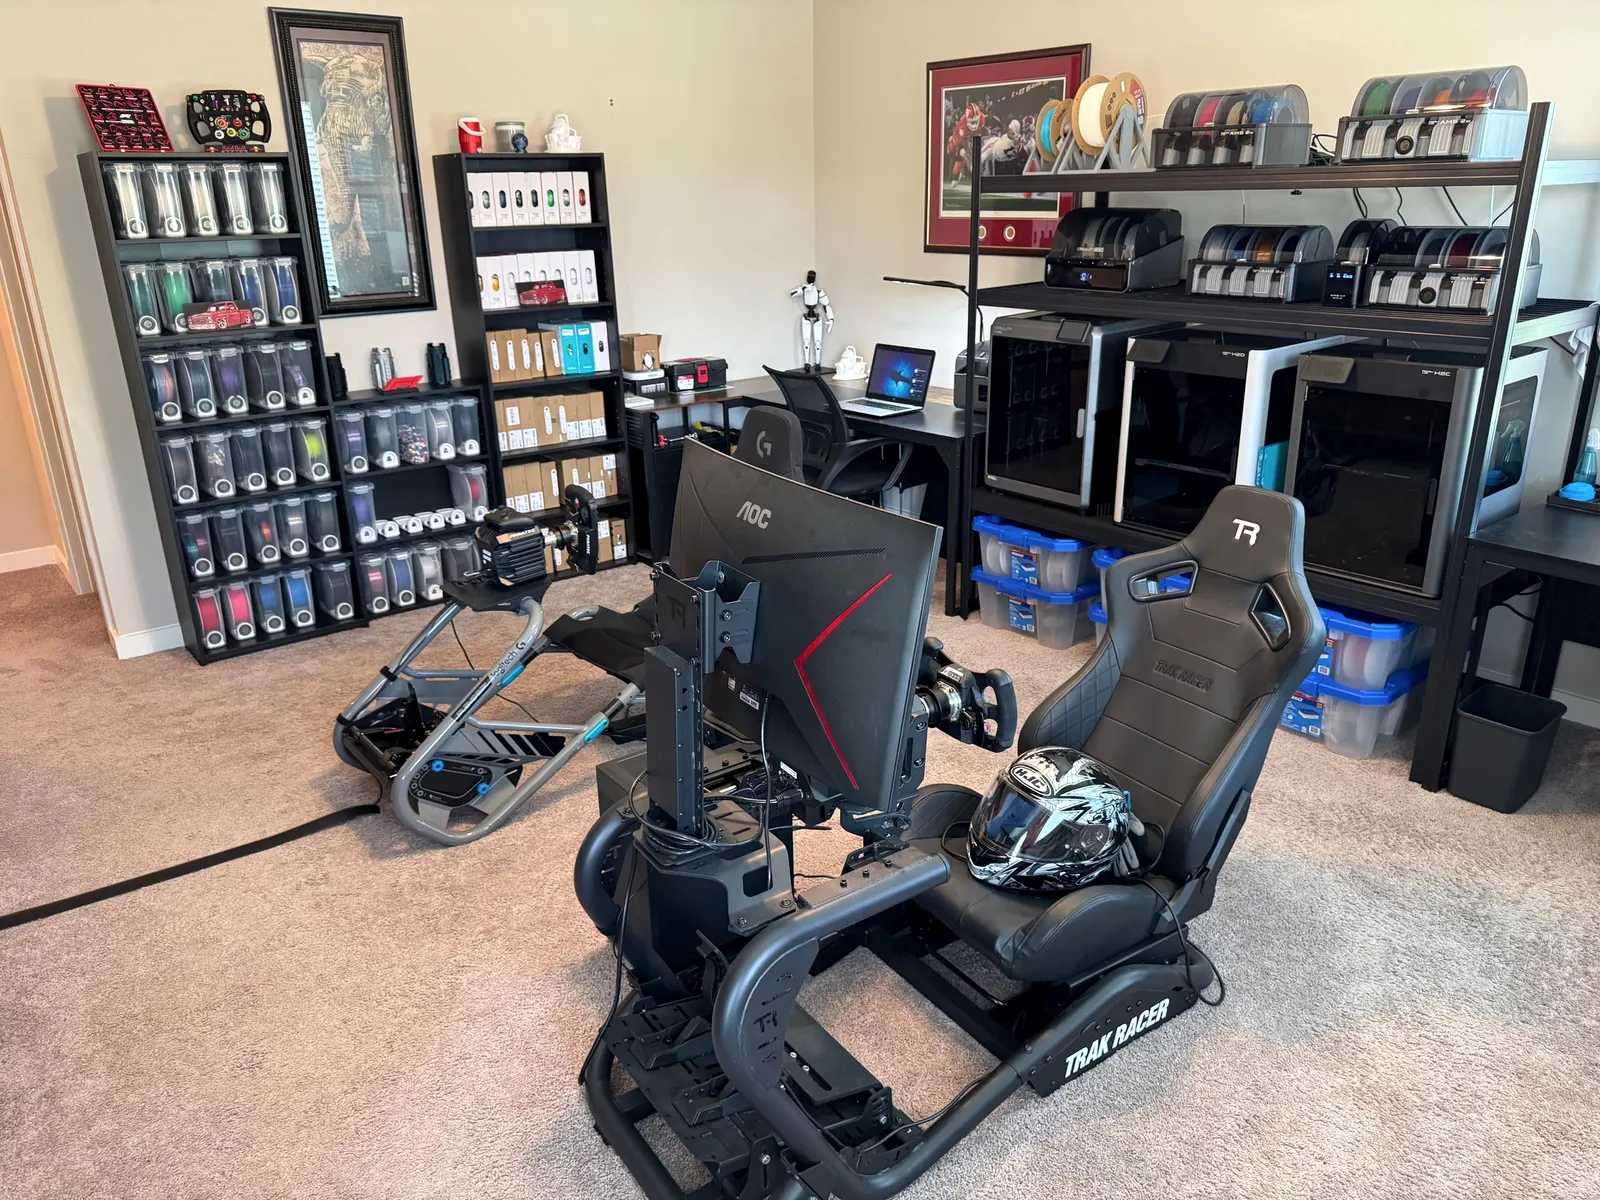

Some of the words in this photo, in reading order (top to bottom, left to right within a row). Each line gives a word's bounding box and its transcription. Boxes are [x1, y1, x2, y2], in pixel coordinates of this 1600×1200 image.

[736, 501, 772, 529] AOC
[1232, 518, 1261, 546] TR
[490, 650, 518, 679] logitech
[1015, 768, 1046, 789] HJC
[1065, 1030, 1114, 1079] TRAK
[1111, 998, 1171, 1049] RACER
